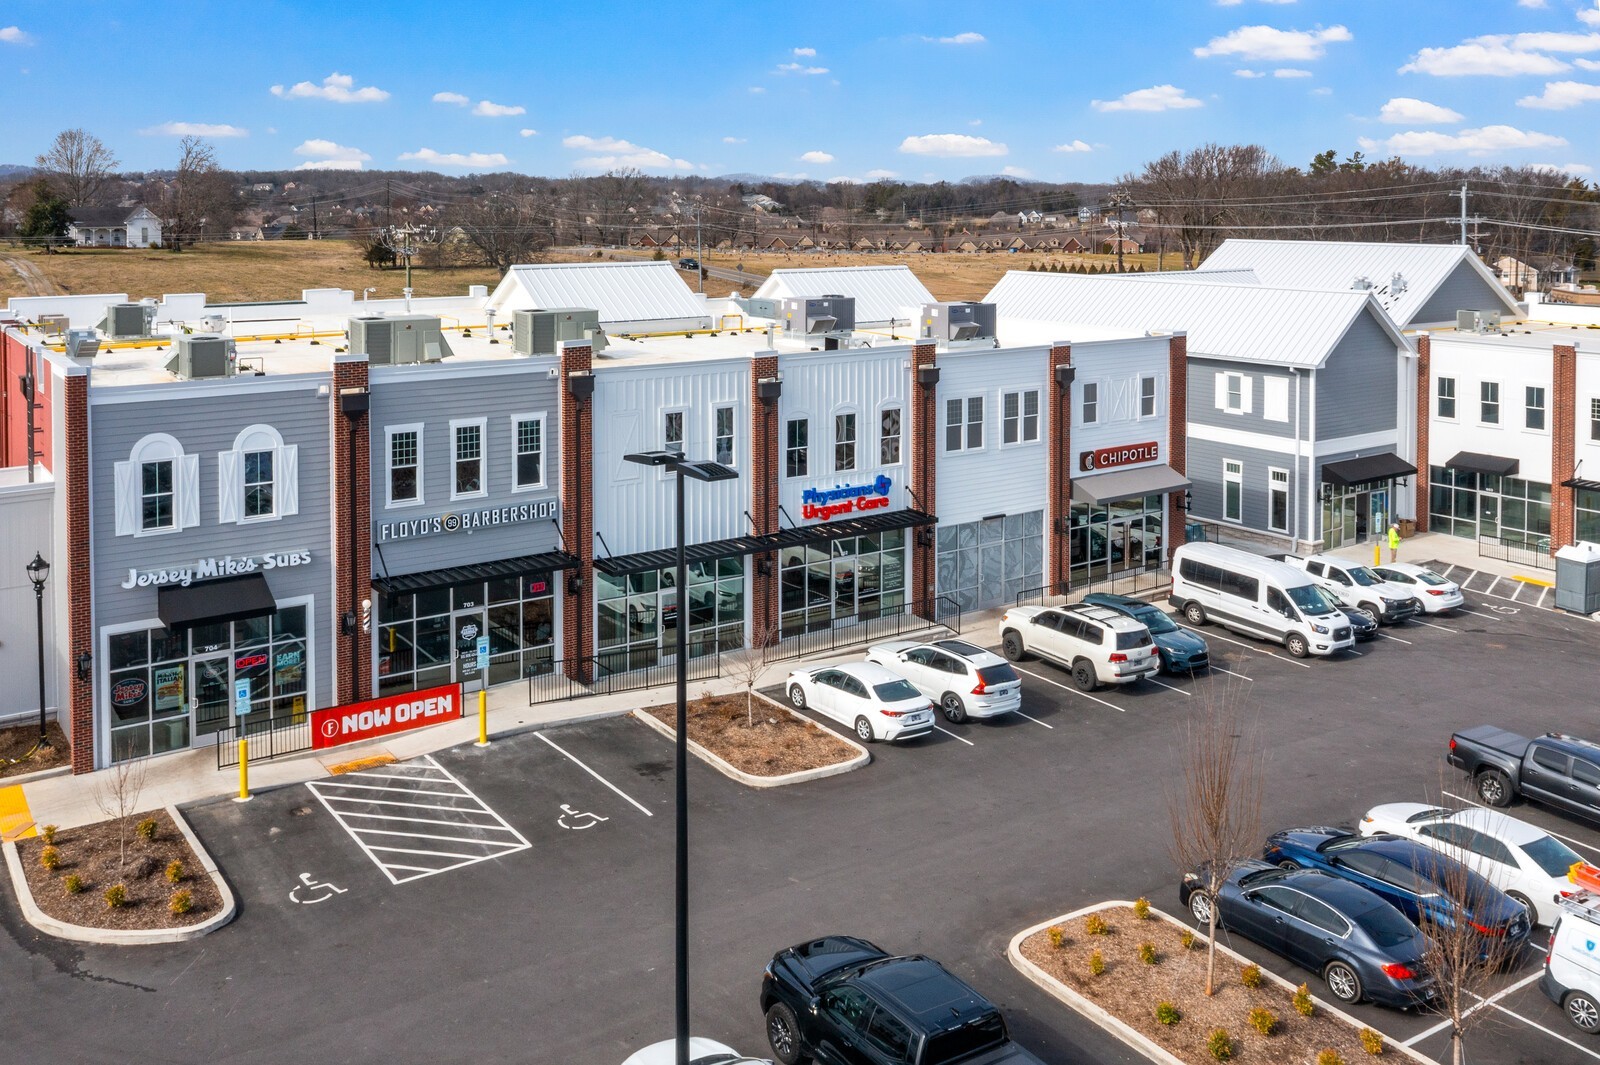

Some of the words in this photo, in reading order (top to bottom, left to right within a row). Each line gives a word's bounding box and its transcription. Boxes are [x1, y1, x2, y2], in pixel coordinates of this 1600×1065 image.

[1100, 446, 1158, 465] CHIPOTLE
[802, 483, 874, 506] Physicians
[802, 500, 853, 521] Urgent
[856, 496, 890, 511] Care
[381, 517, 441, 540] FLOYD'S
[447, 518, 457, 528] 99
[462, 501, 557, 529] BARBERSHOP
[121, 568, 193, 589] Jersey
[197, 556, 258, 579] Mike's
[204, 644, 218, 652] 704
[276, 651, 300, 660] EARN
[236, 654, 267, 668] OPEN
[113, 683, 144, 695] Jersey
[156, 676, 183, 685] ITALIAN
[341, 706, 392, 735] NOW
[395, 694, 453, 723] OPEN
